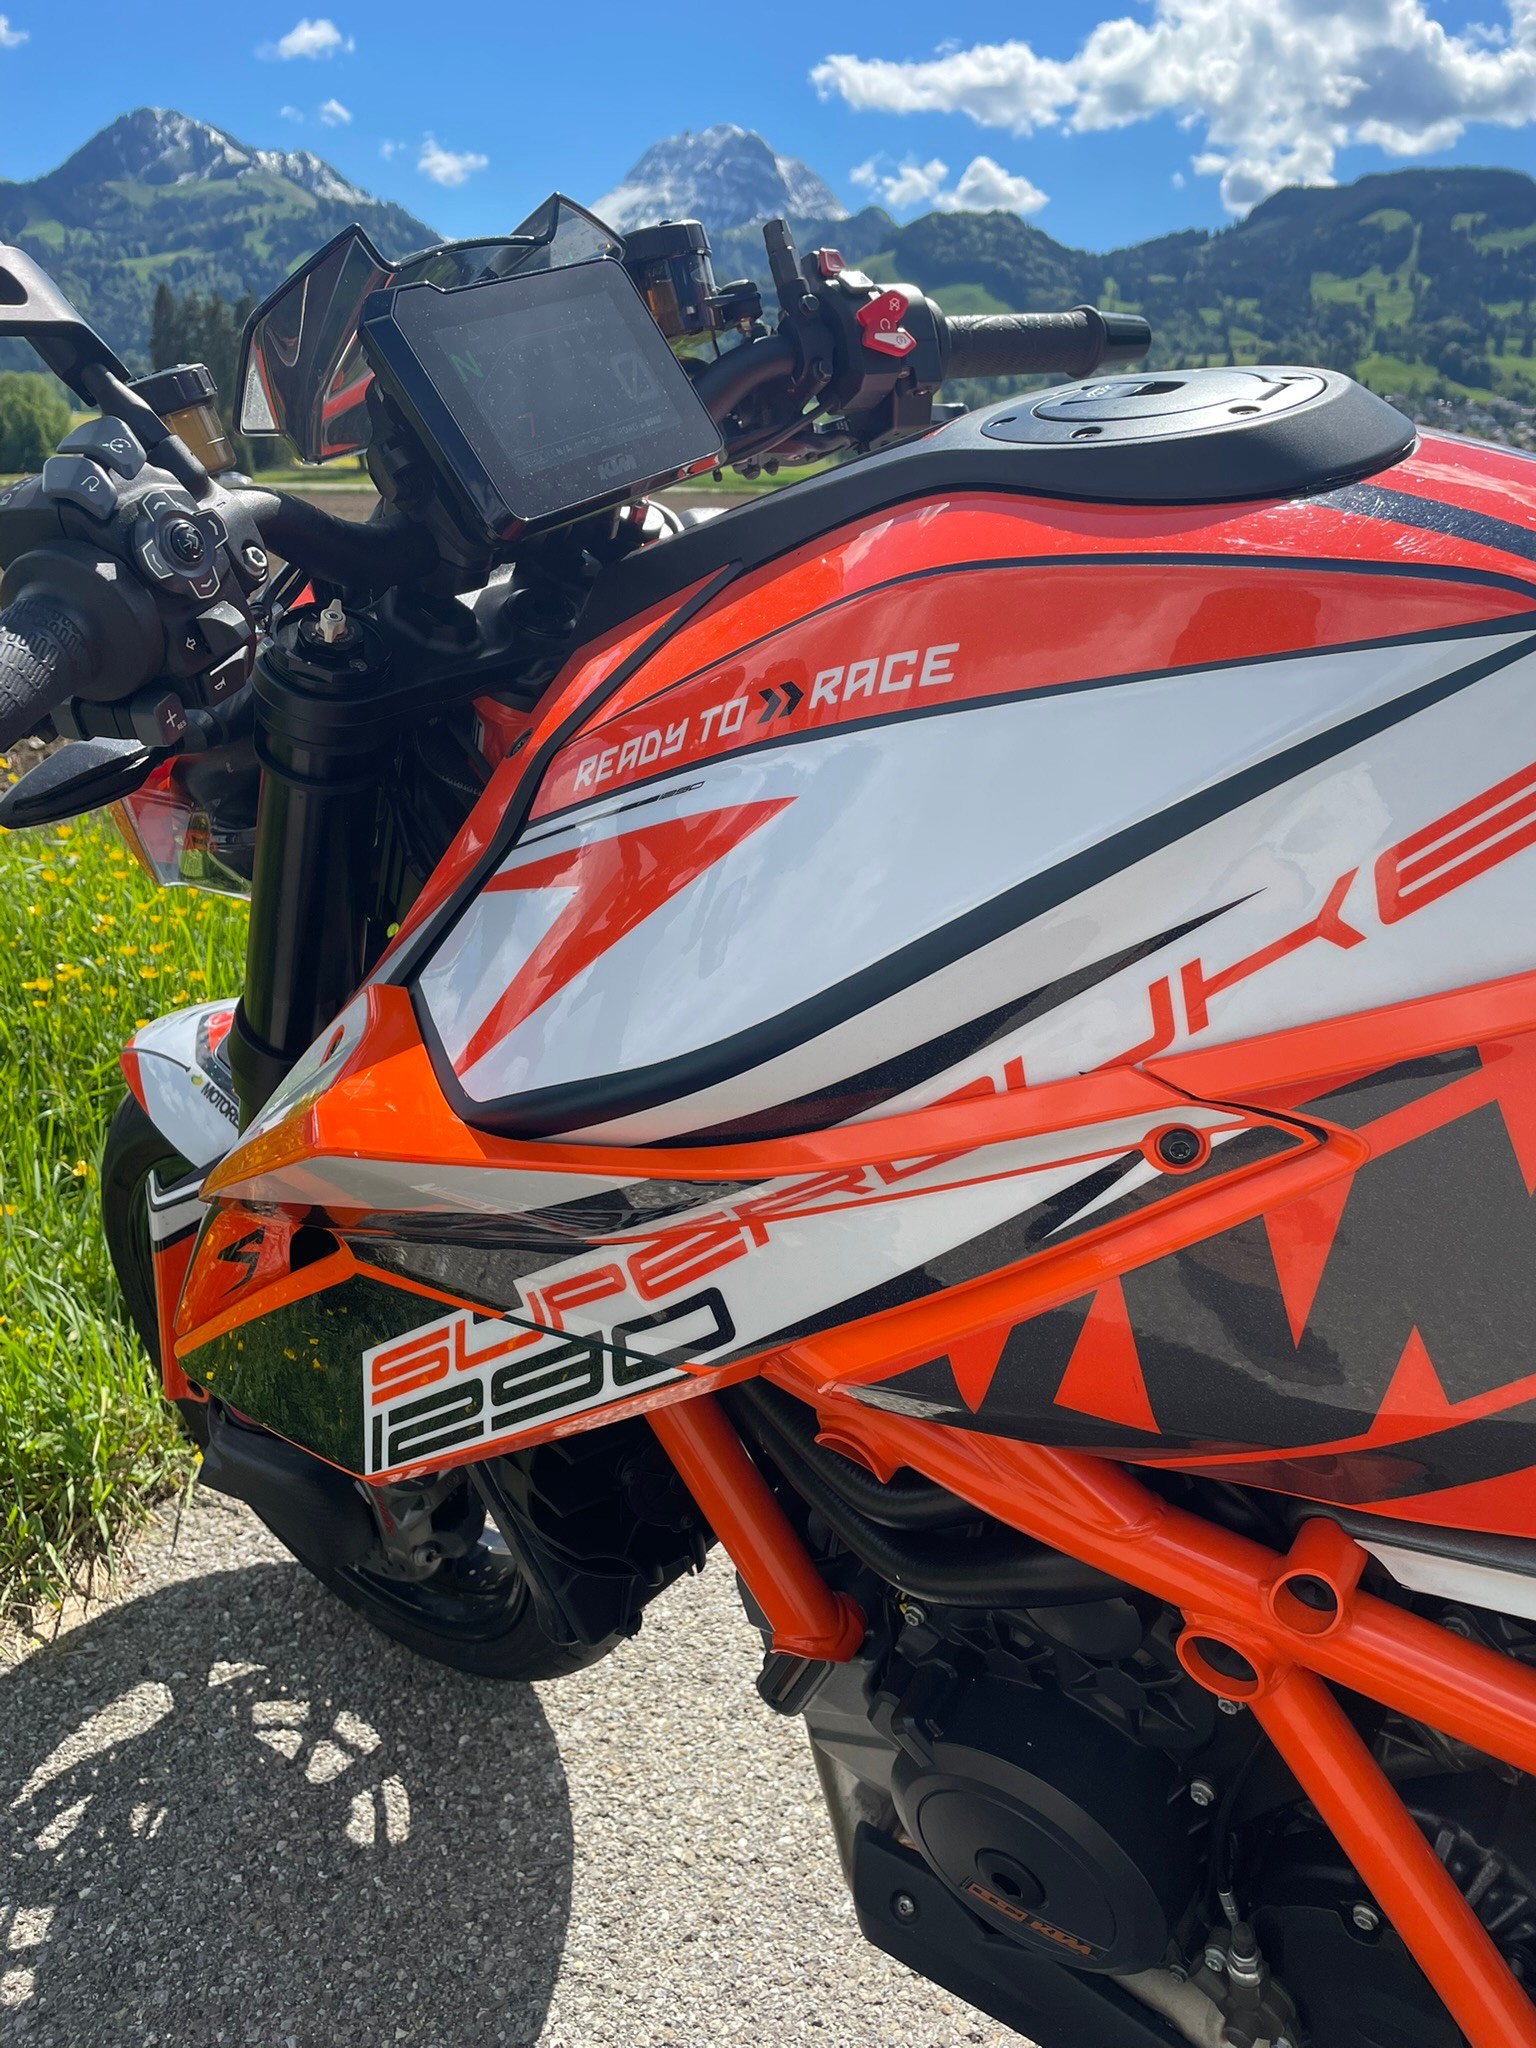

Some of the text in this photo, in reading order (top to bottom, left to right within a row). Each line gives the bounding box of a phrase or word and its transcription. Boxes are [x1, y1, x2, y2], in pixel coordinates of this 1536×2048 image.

[598, 453, 638, 481] KTM
[573, 642, 960, 792] READY TO RACE
